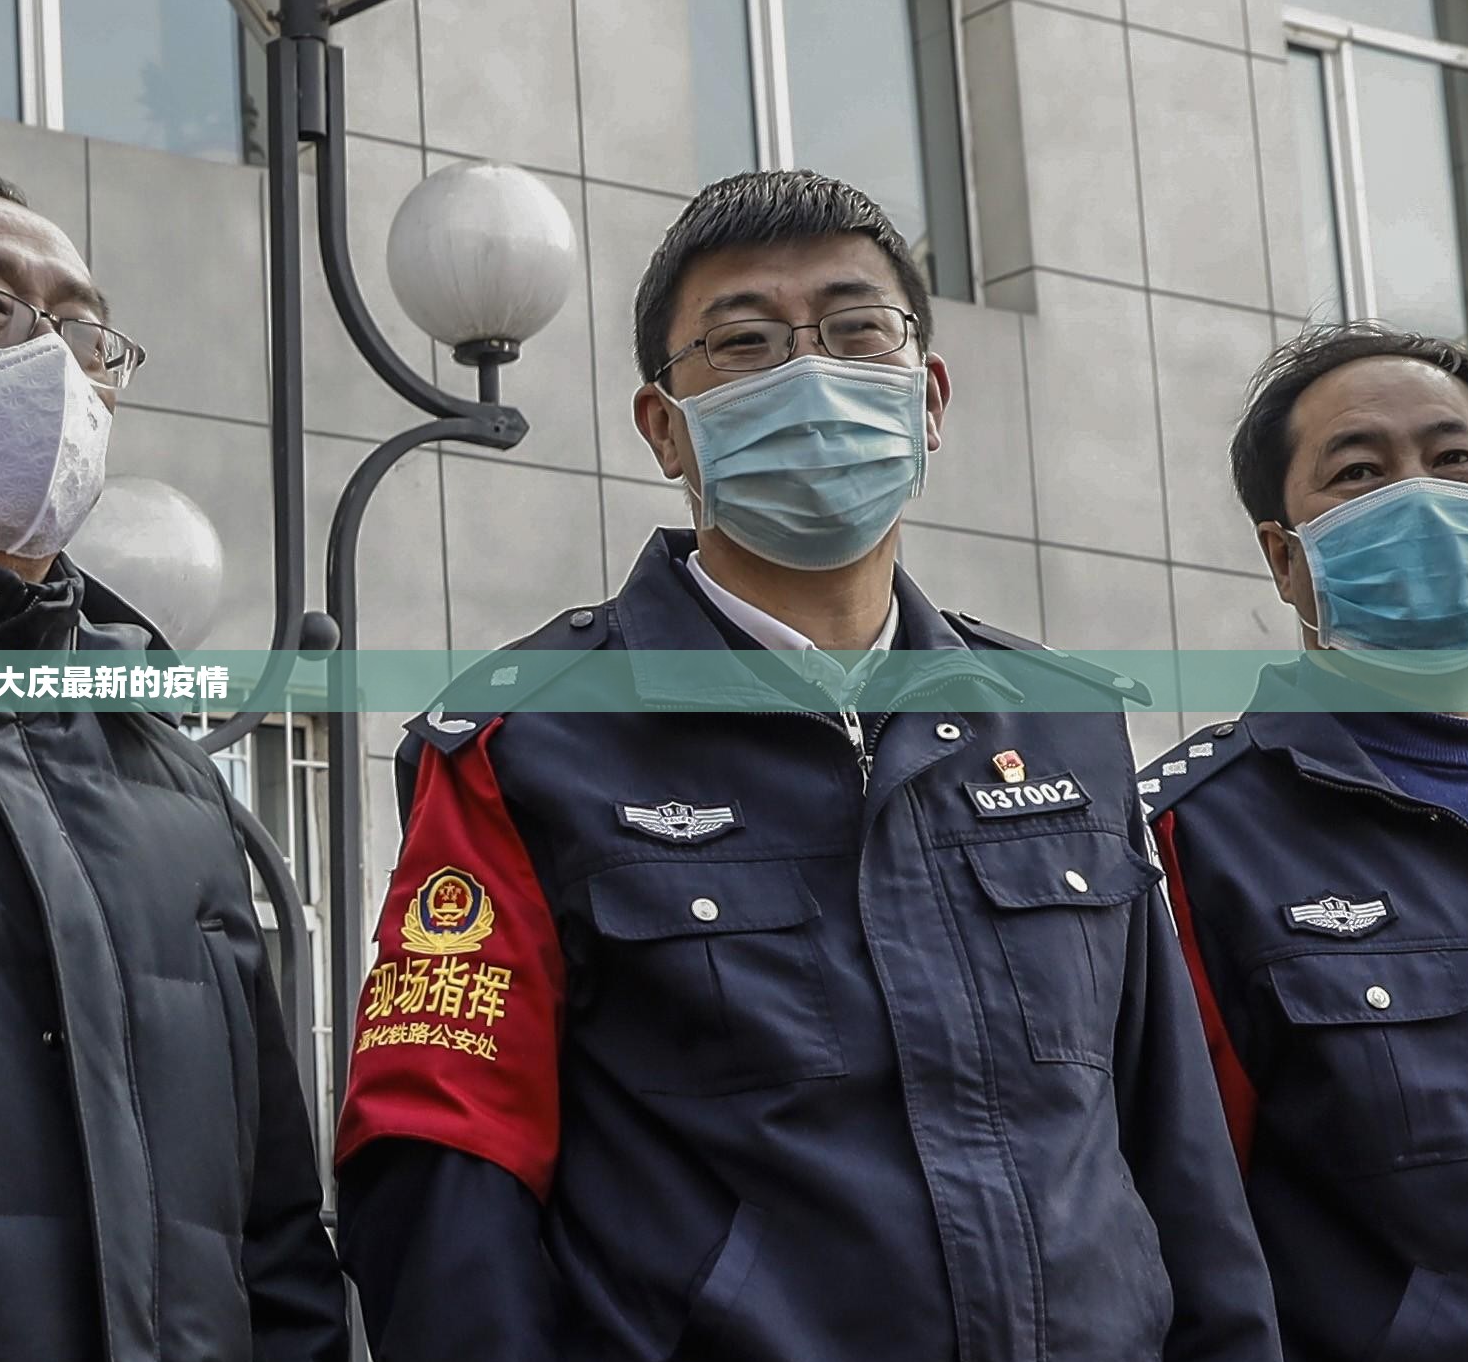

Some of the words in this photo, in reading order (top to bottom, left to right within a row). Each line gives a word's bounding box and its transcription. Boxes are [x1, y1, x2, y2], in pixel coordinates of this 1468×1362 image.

[976, 780, 1080, 810] 037002
[365, 956, 512, 1027] 现场指挥
